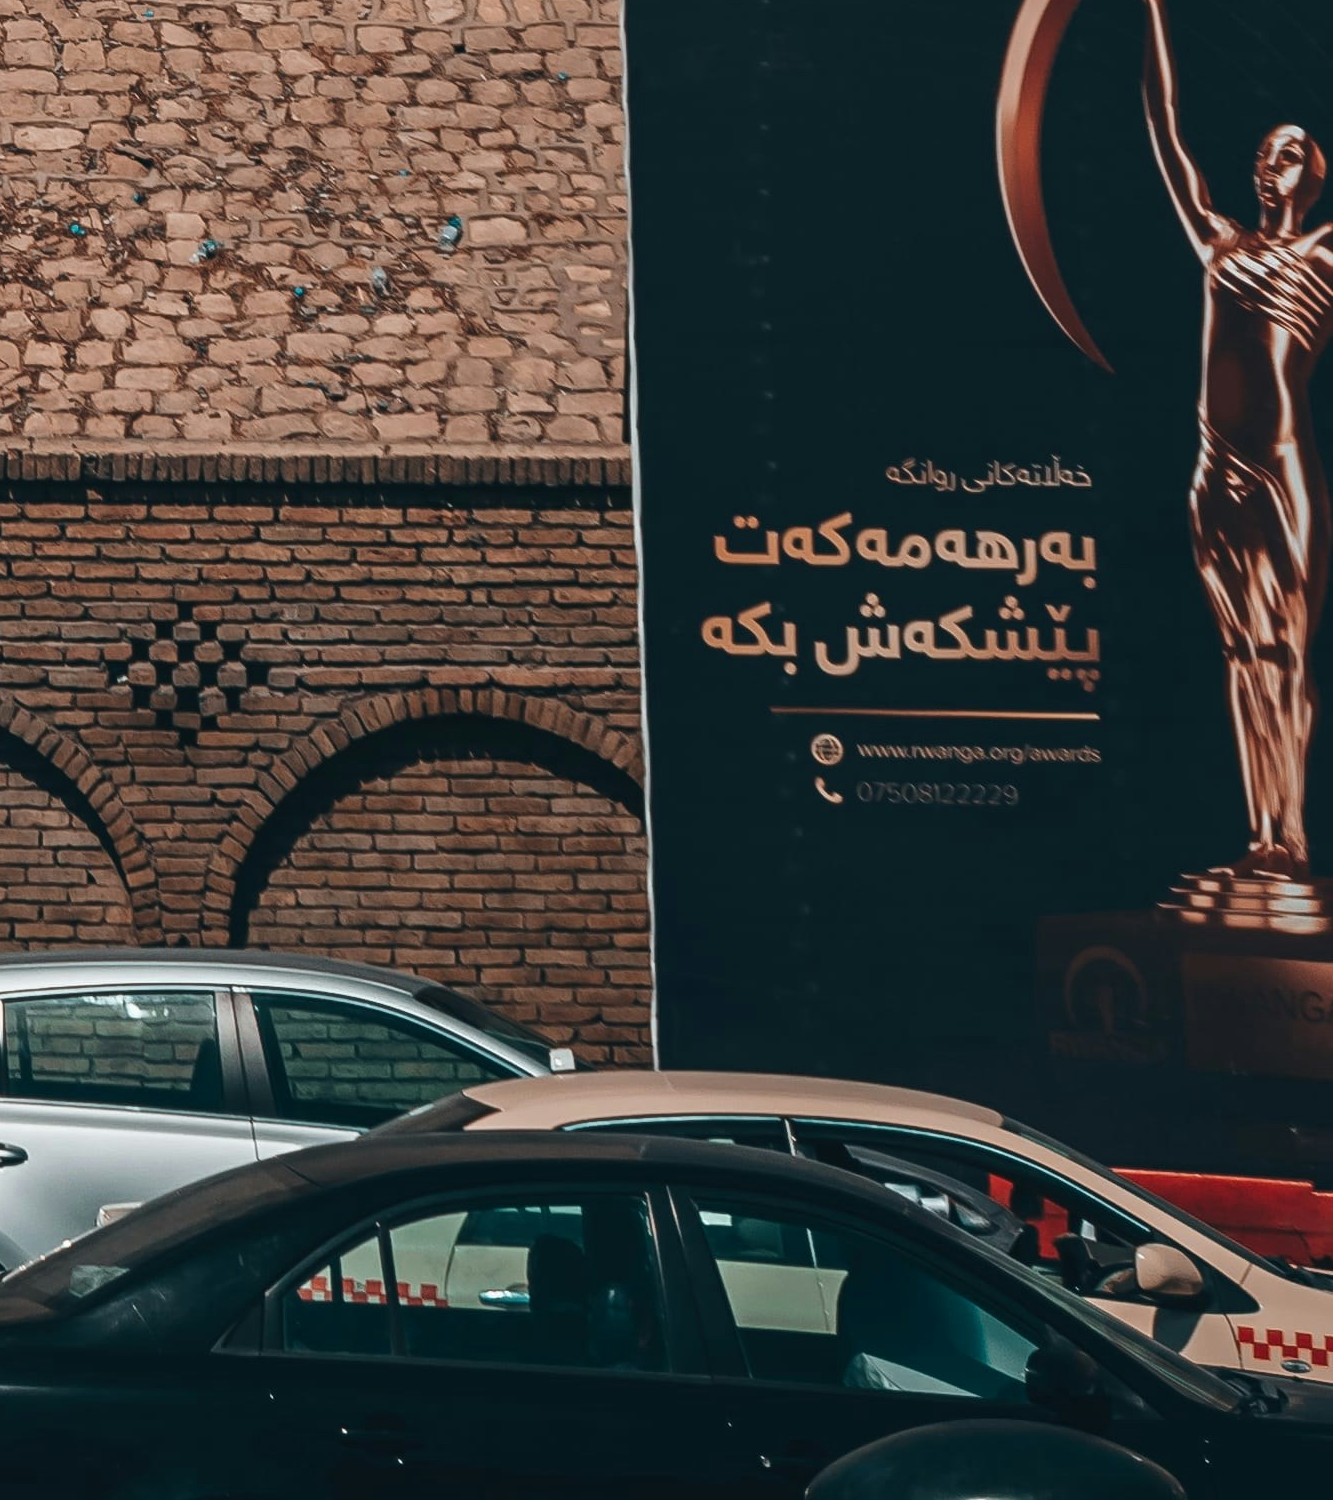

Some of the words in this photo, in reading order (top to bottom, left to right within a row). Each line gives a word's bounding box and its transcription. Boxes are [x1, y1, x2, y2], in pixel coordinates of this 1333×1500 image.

[700, 601, 799, 677] بکە
[813, 591, 1102, 694] پێشکەش
[856, 741, 1103, 766] www.rwanga.org/awards
[856, 782, 1020, 806] 07508122229
